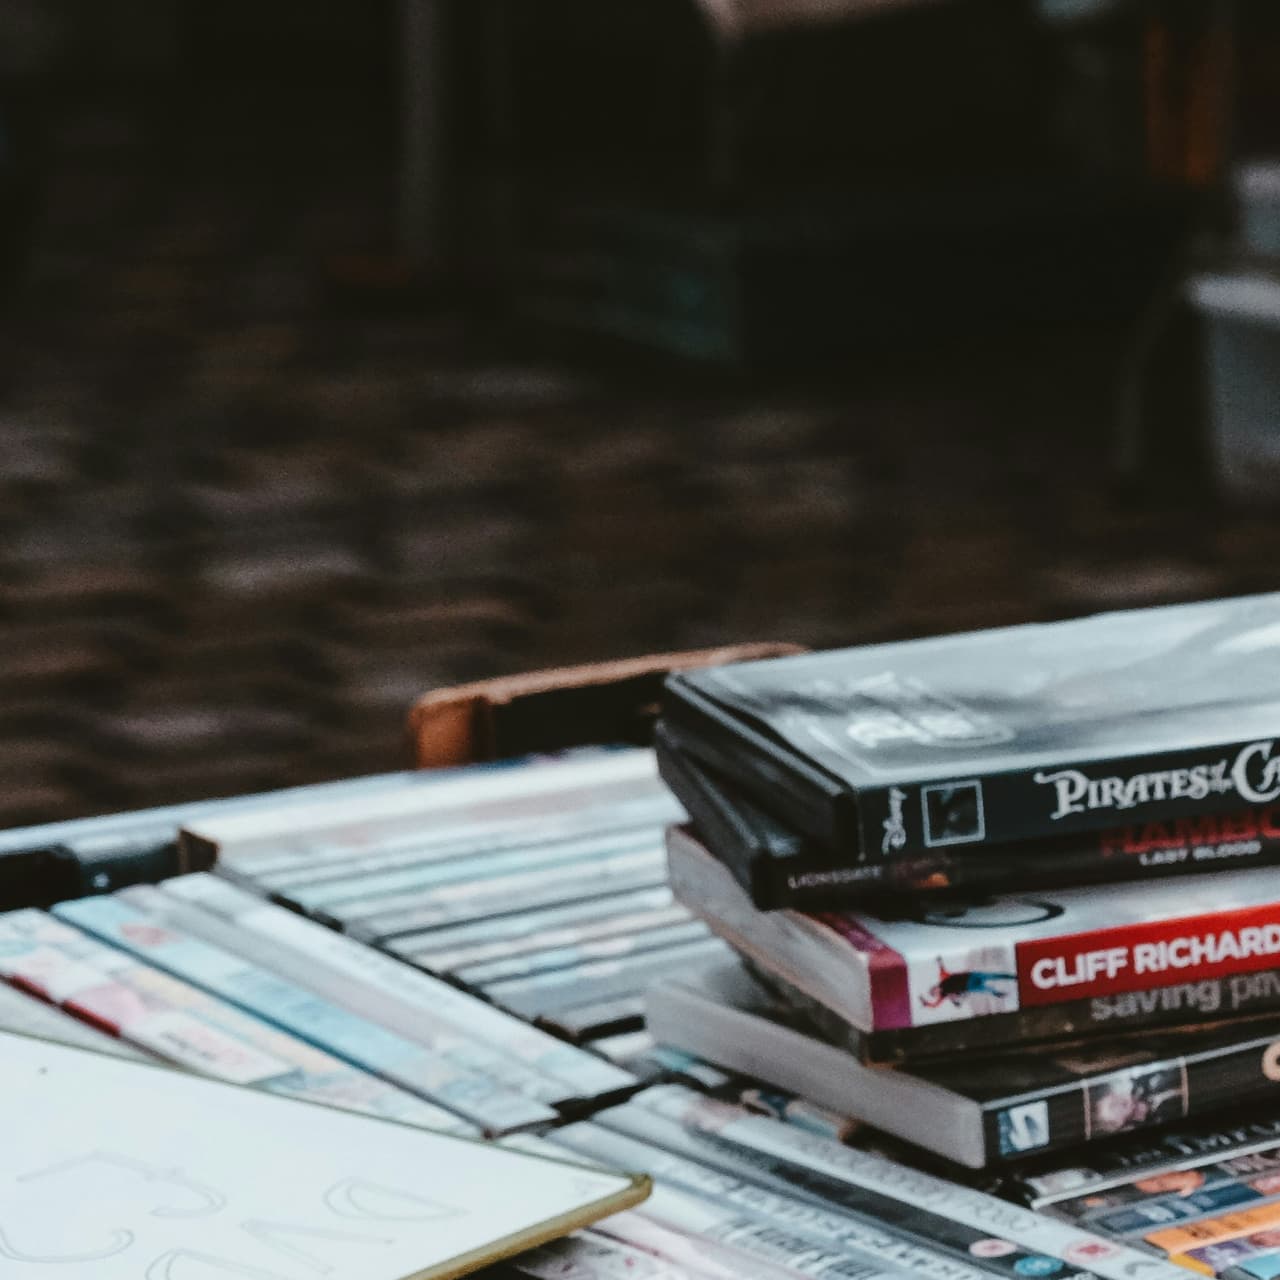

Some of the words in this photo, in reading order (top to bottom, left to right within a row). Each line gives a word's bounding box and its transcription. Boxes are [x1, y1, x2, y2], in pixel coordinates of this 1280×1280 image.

[1034, 763, 1209, 820] PIRATES
[1139, 844, 1200, 867] LAST
[1204, 838, 1262, 861] BLOOD
[1031, 946, 1127, 990] CLIFF
[1090, 977, 1221, 1022] saving
